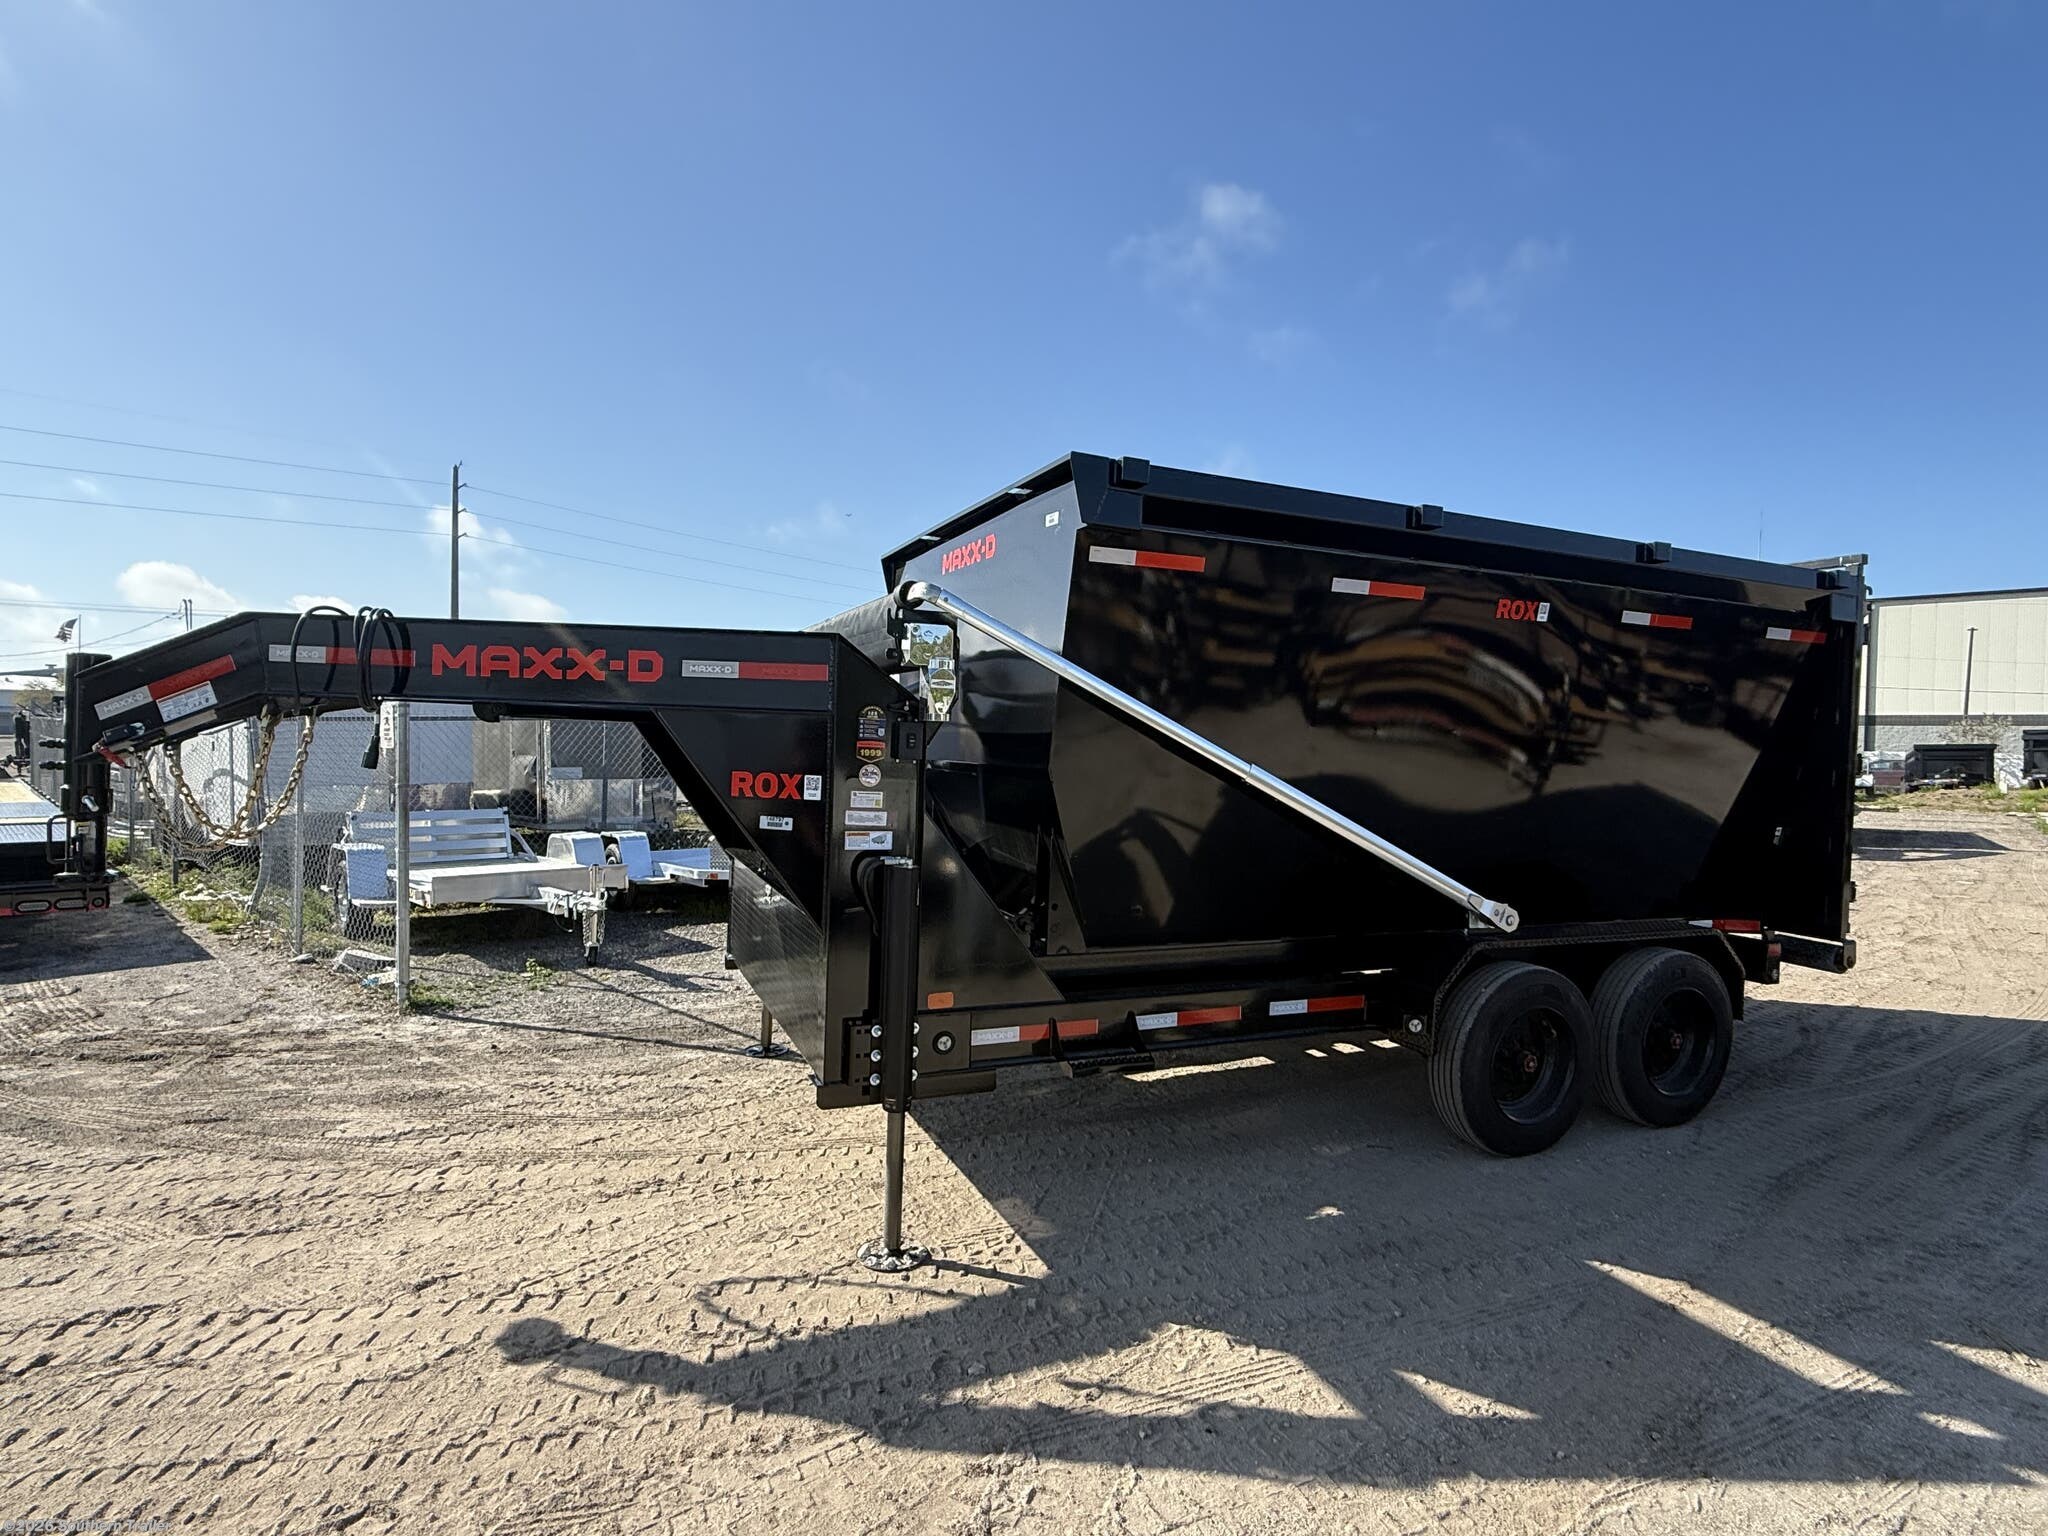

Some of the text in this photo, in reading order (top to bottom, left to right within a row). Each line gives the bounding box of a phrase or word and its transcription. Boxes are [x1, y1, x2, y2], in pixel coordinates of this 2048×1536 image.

[942, 533, 996, 575] MAXX-D
[1496, 598, 1539, 622] ROX
[431, 643, 664, 683] MAXX-D
[689, 665, 732, 674] MAXX-D
[103, 693, 144, 713] MAXX-D
[859, 748, 882, 757] 1999
[730, 770, 803, 800] ROX
[977, 1031, 1014, 1041] MAXX-D
